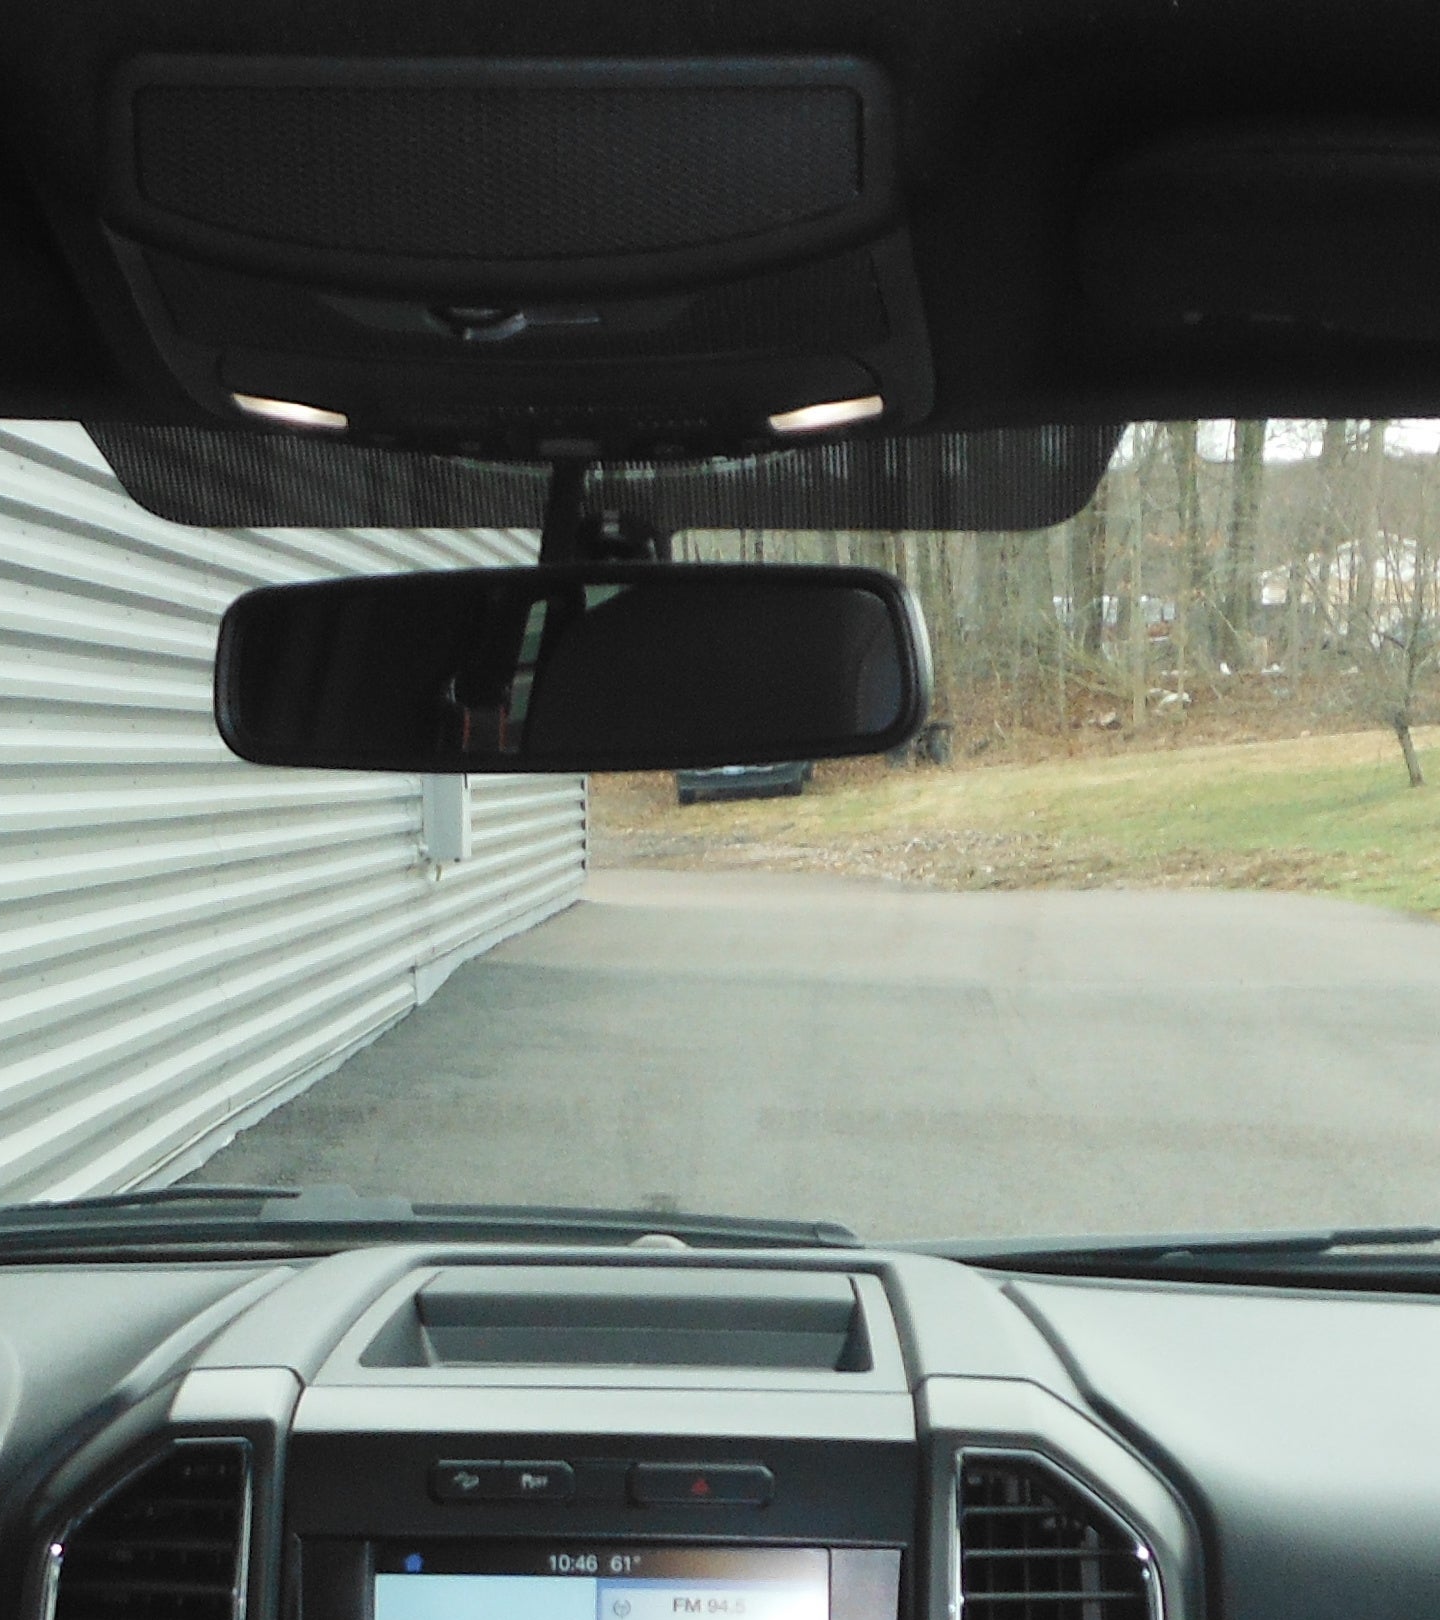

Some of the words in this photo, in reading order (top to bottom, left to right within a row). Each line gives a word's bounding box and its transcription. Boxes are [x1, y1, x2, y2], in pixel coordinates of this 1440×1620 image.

[550, 1554, 598, 1572] 10:46
[672, 1597, 701, 1614] FM
[707, 1598, 747, 1615] 94.5
